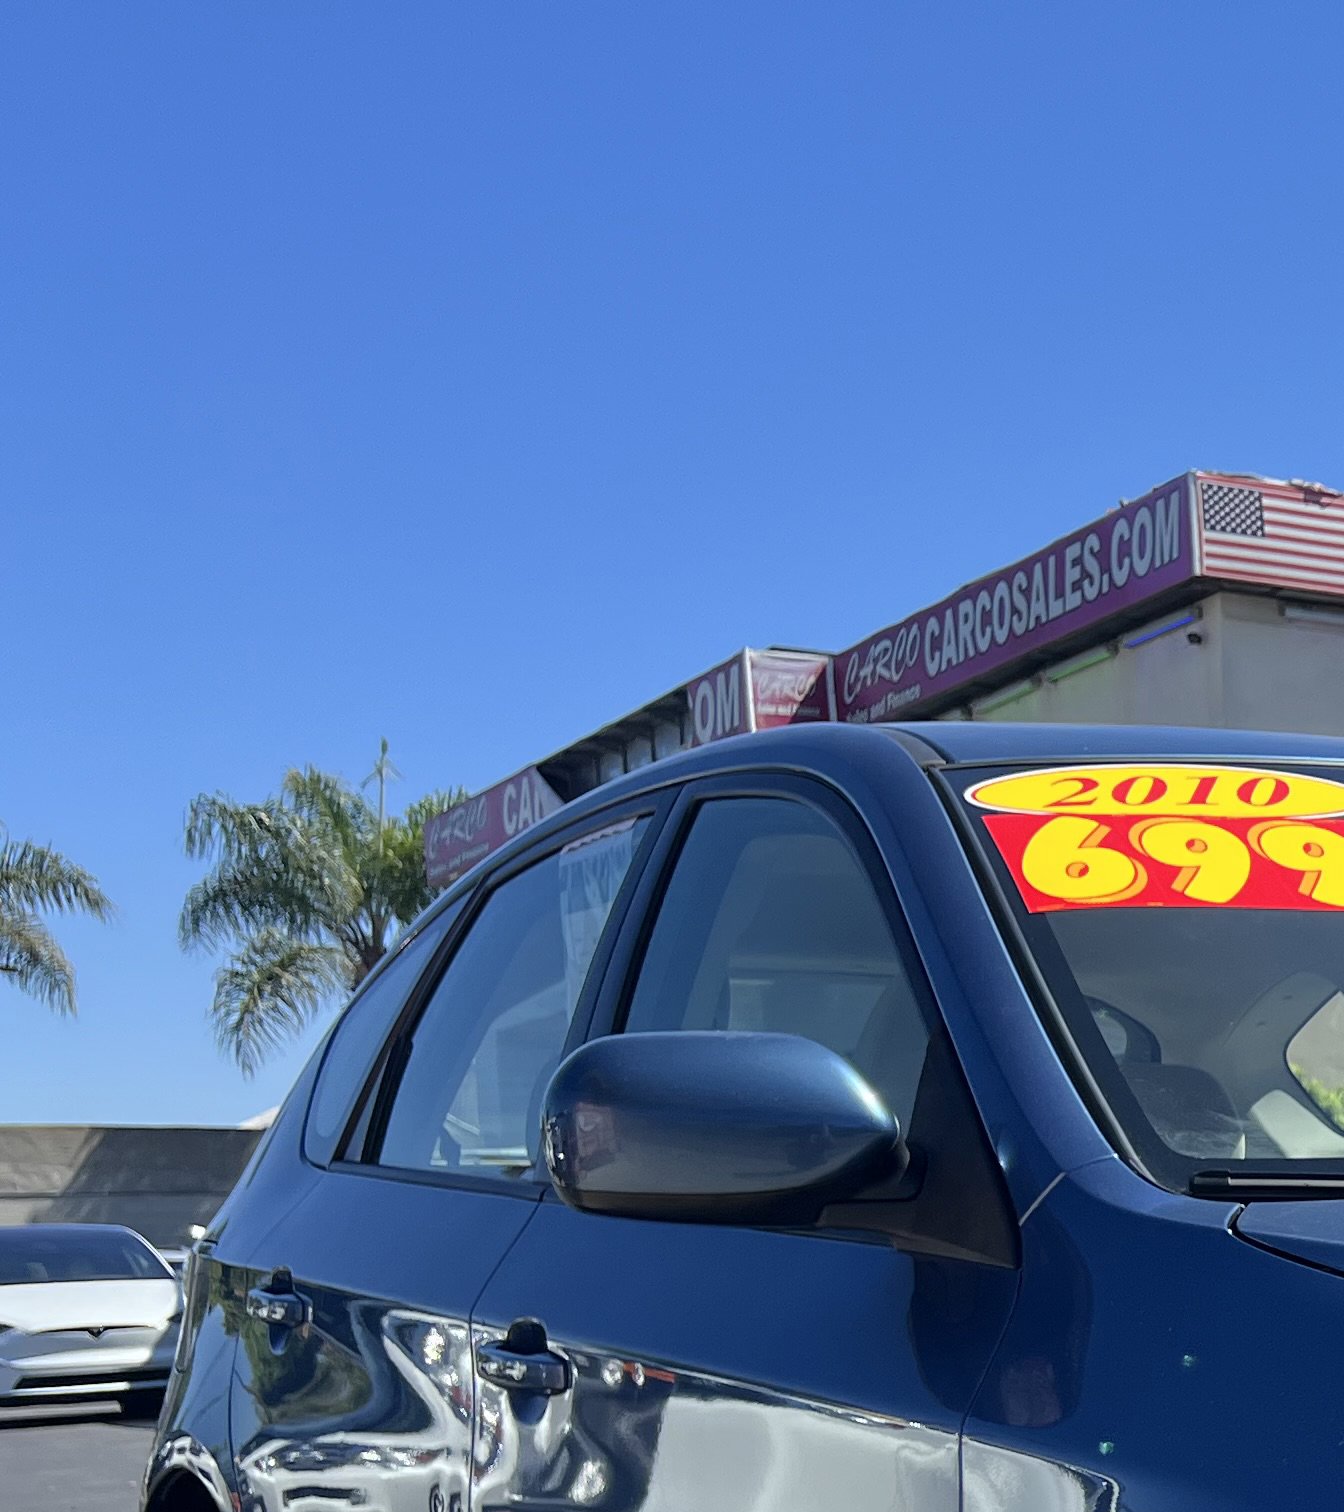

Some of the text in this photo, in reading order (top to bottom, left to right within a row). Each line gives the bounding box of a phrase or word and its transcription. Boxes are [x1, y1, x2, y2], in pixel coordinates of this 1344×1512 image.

[924, 489, 1182, 679] CARCOSALES.COM
[844, 623, 921, 704] CARCO
[1042, 775, 1291, 808] 2010
